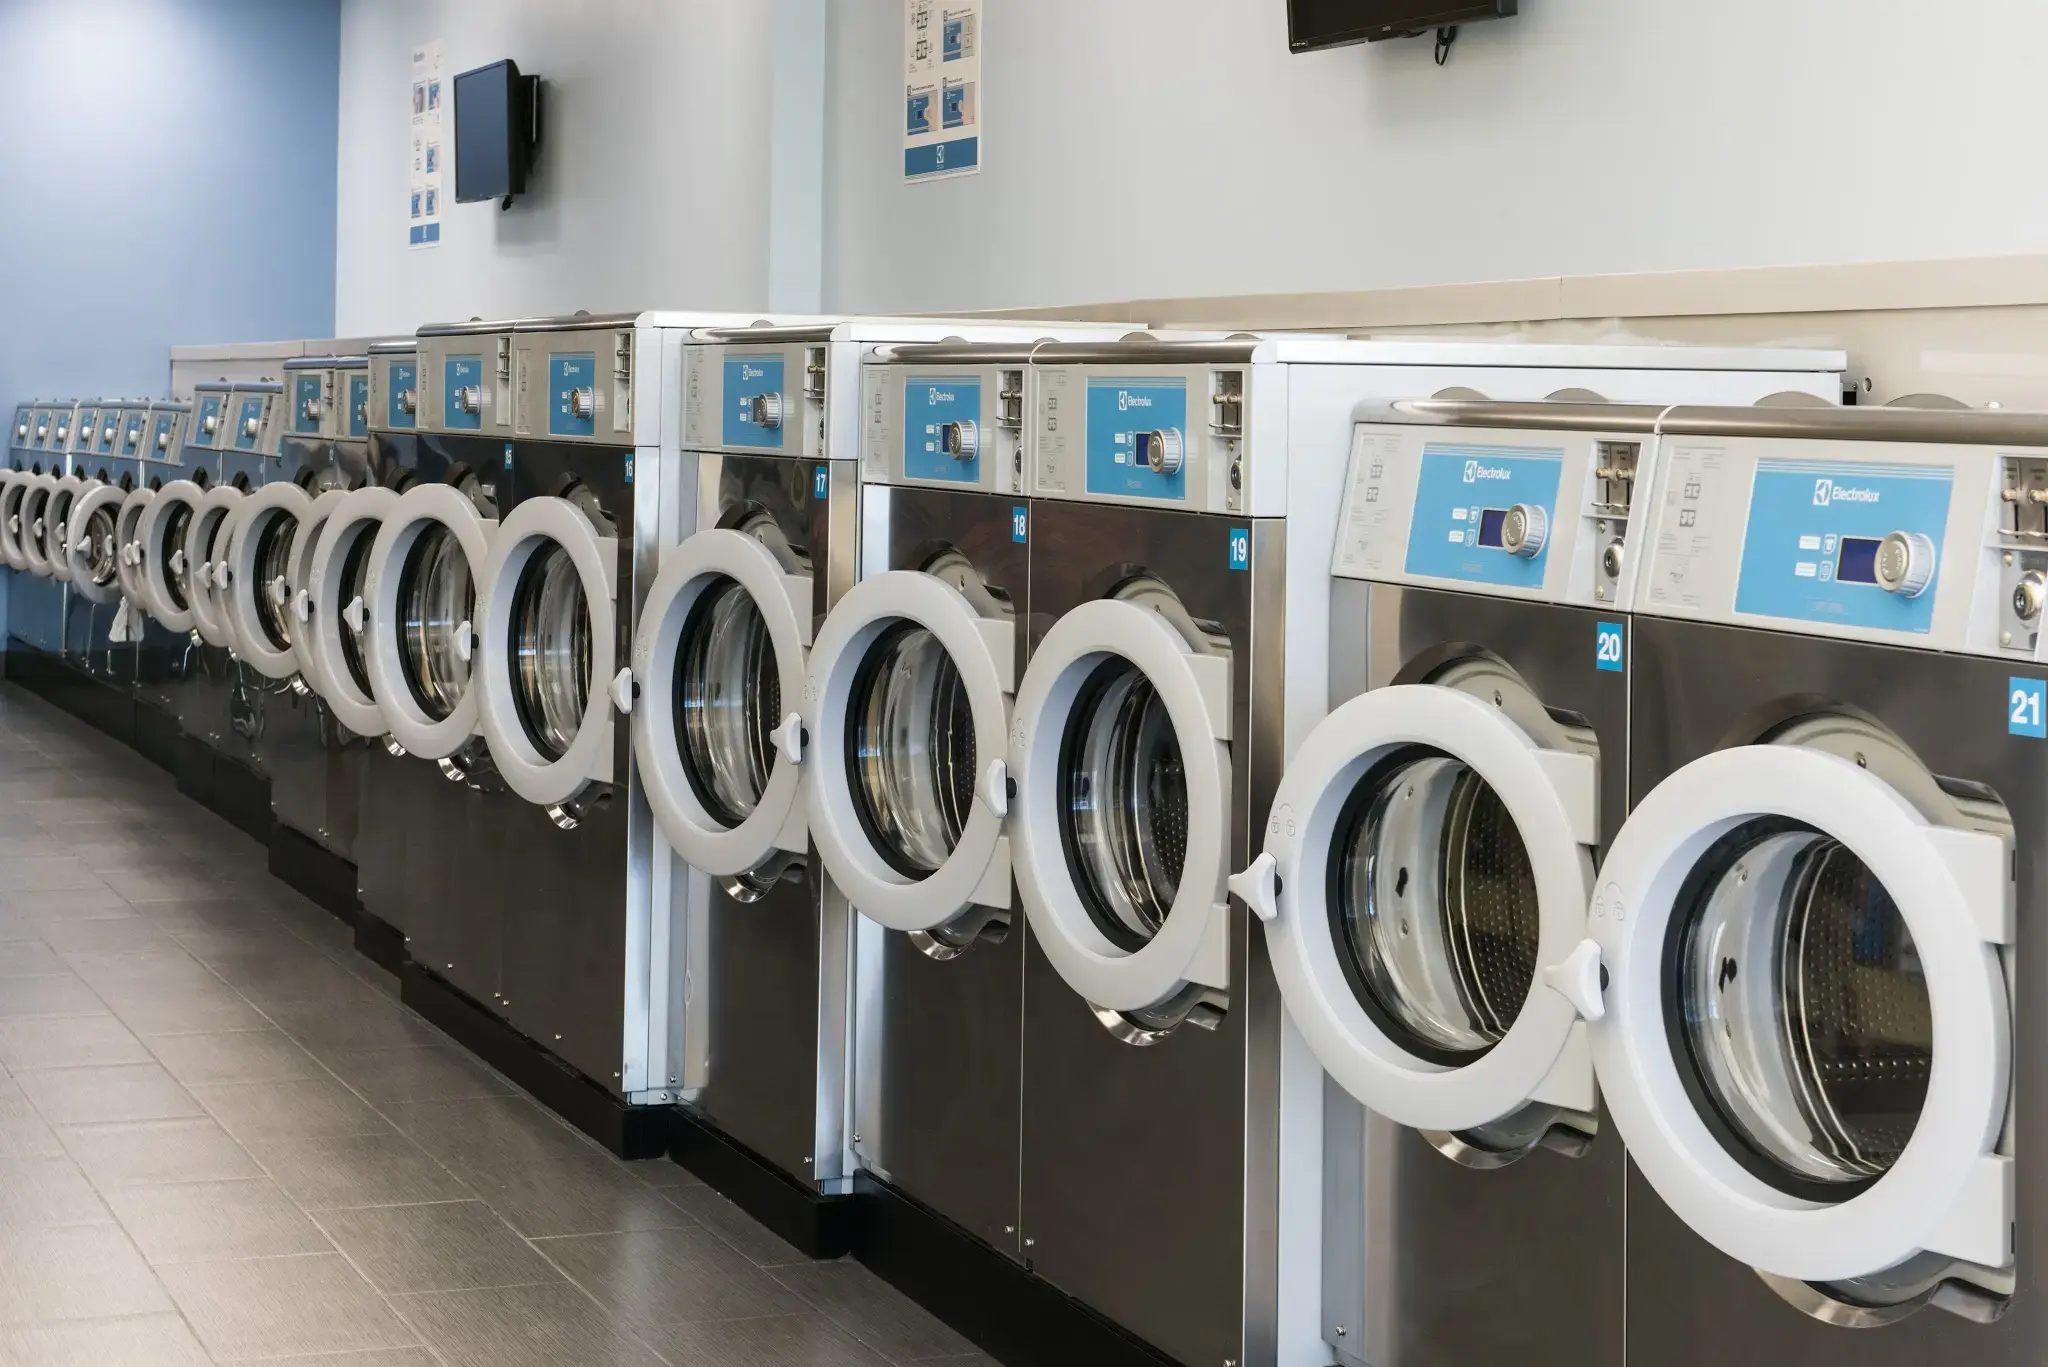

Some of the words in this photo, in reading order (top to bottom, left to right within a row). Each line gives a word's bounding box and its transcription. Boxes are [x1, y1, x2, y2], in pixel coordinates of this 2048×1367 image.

[1128, 395, 1152, 406] Electrolux
[625, 460, 633, 477] 16
[1477, 466, 1512, 480] Electrolux
[816, 473, 826, 492] 17
[1832, 485, 1880, 503] Electrolux
[1013, 514, 1026, 536] 18
[1231, 537, 1247, 562] 19
[1598, 632, 1621, 662] 20
[2011, 689, 2040, 726] 21
